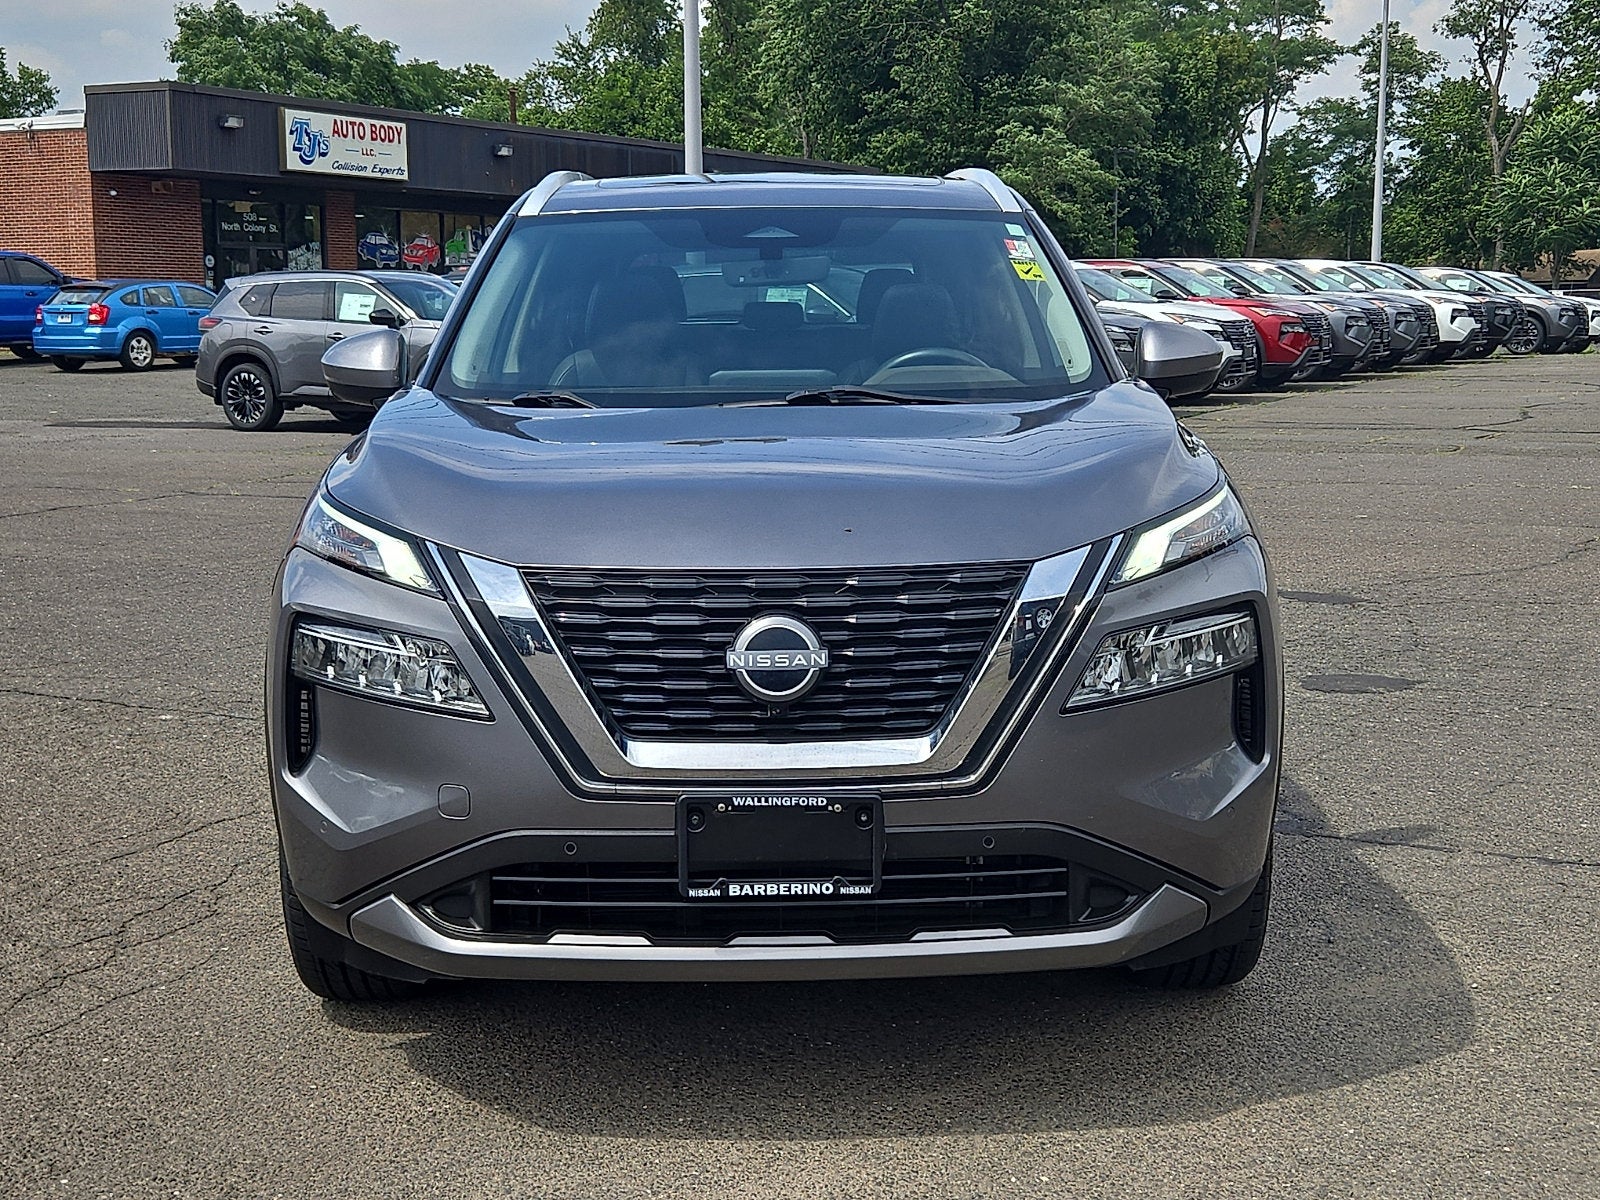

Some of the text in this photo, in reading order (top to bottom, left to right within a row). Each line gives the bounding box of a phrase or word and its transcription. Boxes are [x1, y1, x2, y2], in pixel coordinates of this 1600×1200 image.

[332, 118, 403, 144] AUTO BODY
[361, 148, 377, 158] LLC.
[331, 160, 406, 176] Collision Experts
[243, 212, 258, 222] 508
[221, 222, 241, 232] North
[243, 222, 267, 234] Colony
[729, 653, 826, 667] NISSAN
[732, 797, 828, 807] WALLINGFORD
[688, 882, 872, 898] NISSAN BARBERINO NISSAN
